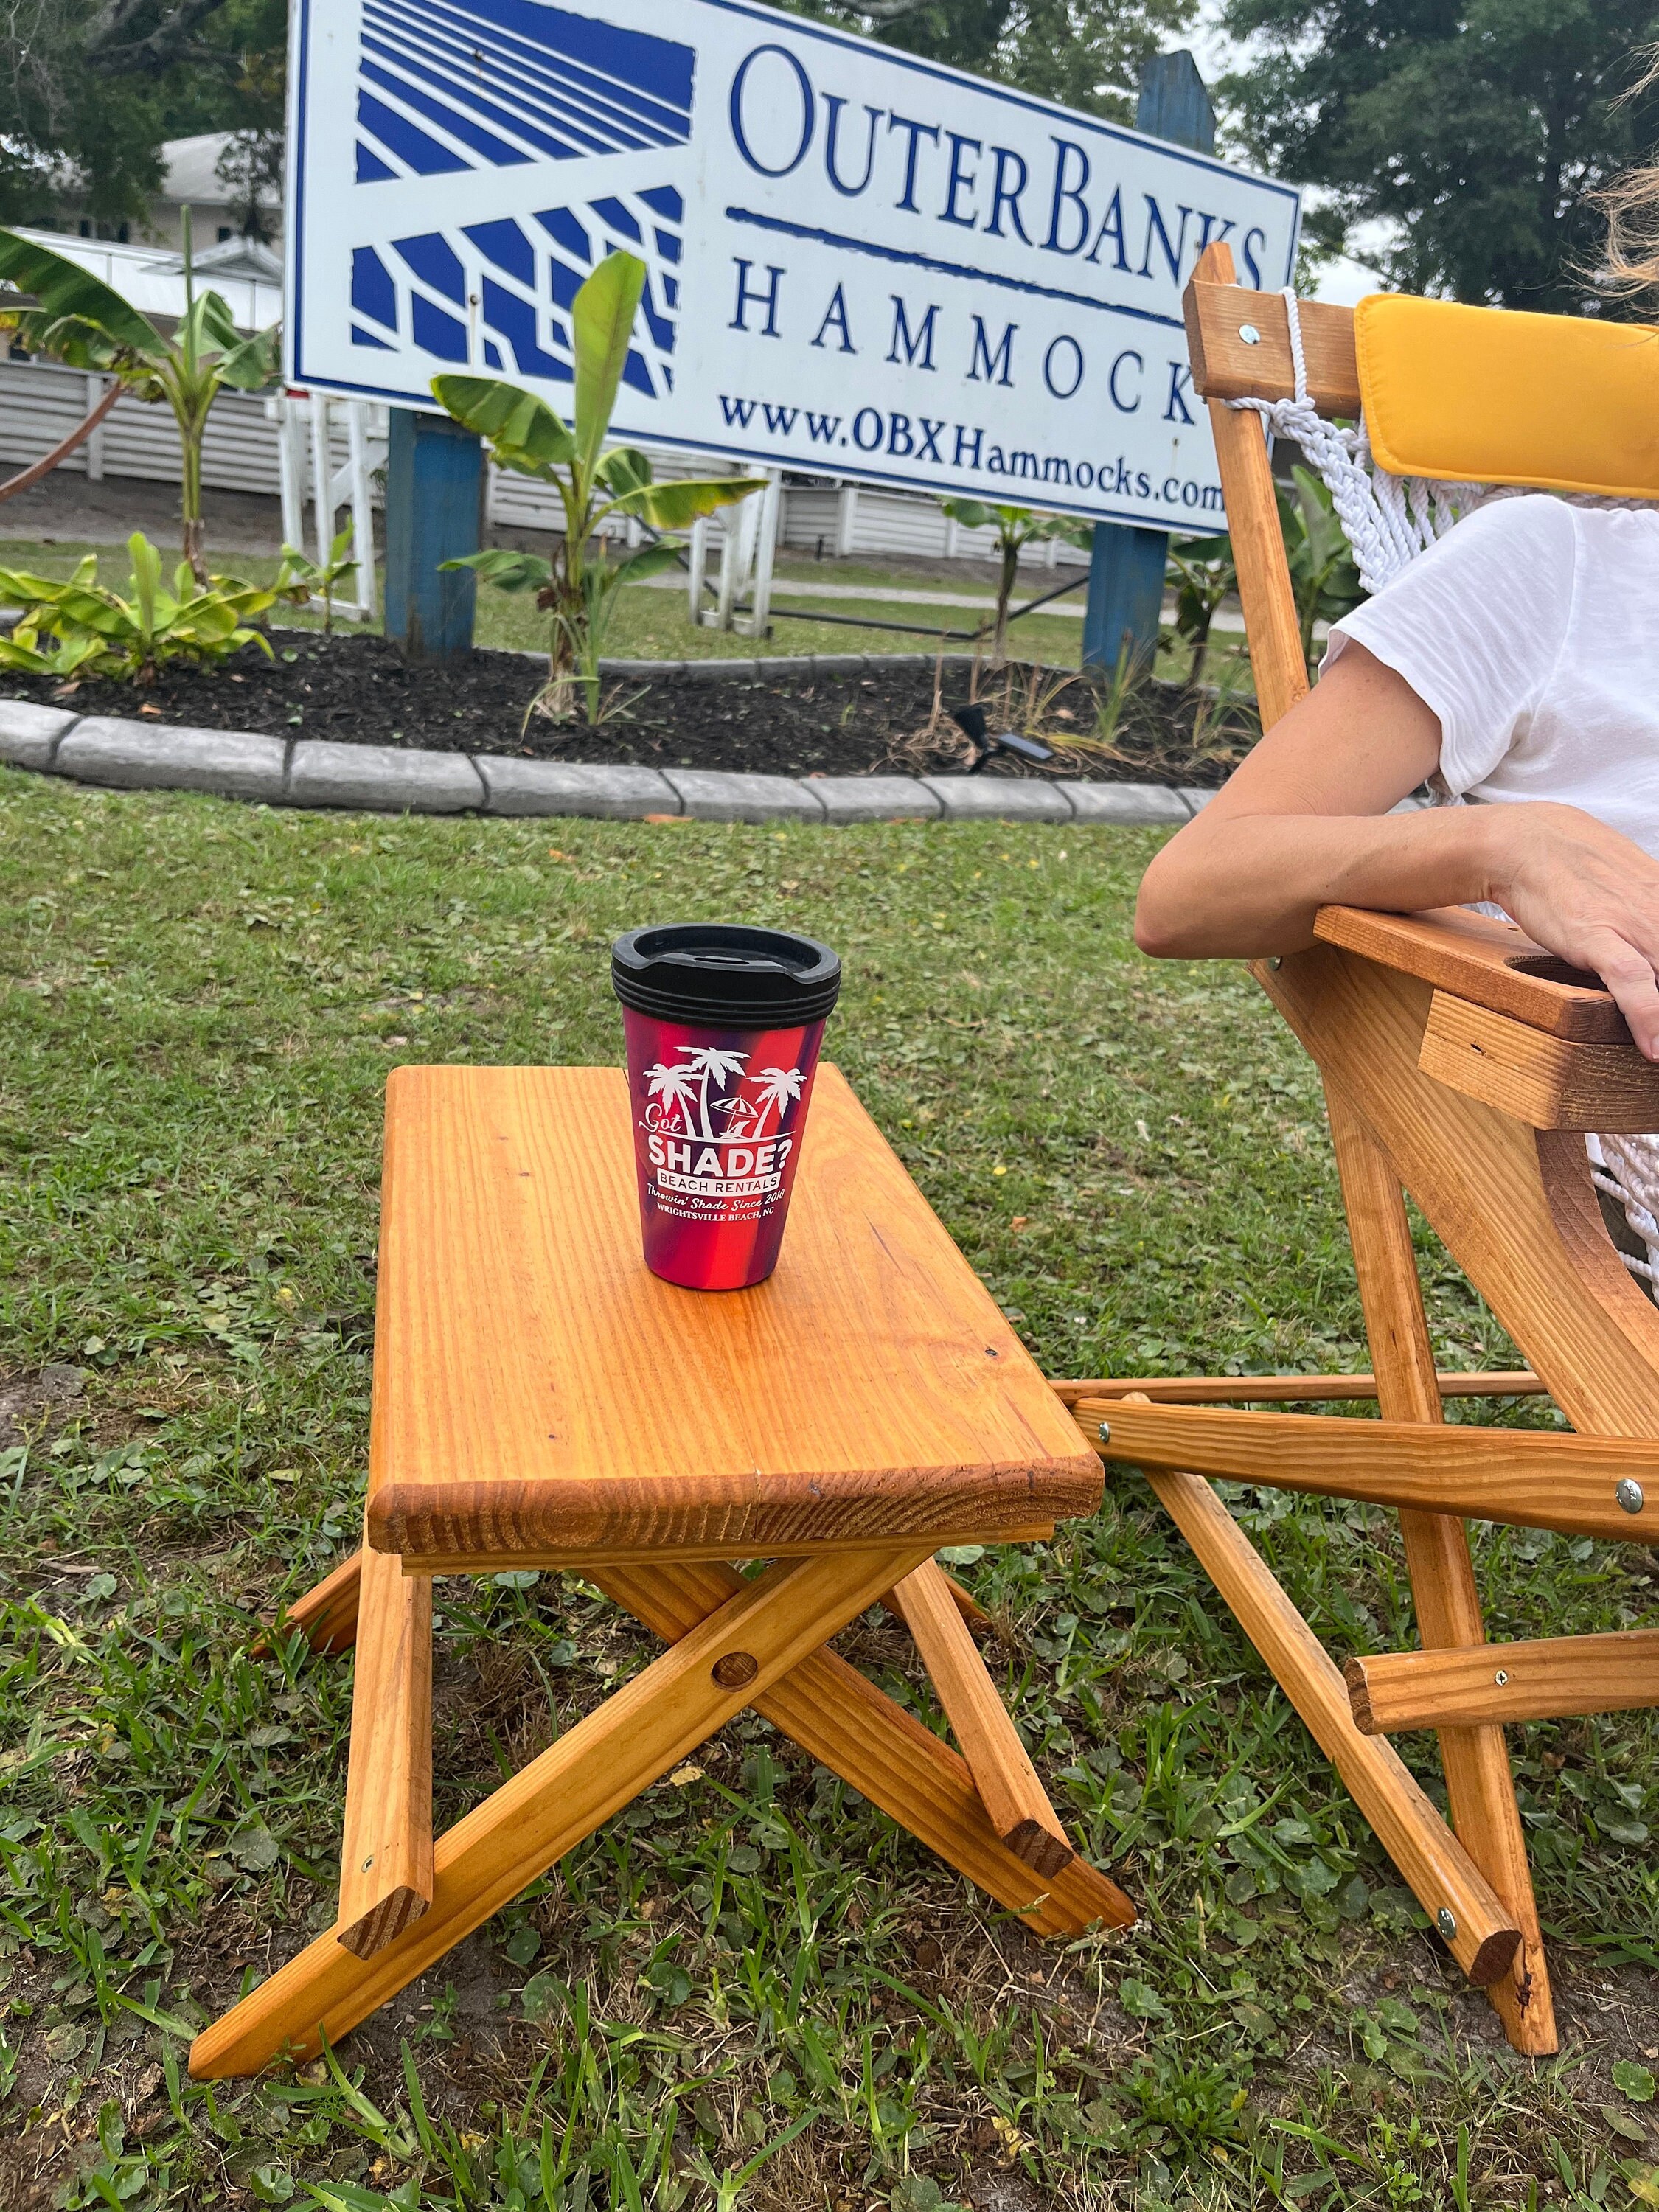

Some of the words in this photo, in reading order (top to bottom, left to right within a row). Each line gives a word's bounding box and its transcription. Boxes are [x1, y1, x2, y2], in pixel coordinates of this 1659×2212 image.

[719, 395, 1225, 511] www.OBXHammocks.com
[639, 1102, 683, 1133] Got
[648, 1134, 793, 1178] SHADE?
[647, 1183, 689, 1206] Throwin'
[690, 1198, 729, 1211] Shade
[731, 1199, 762, 1211] Since
[764, 1189, 785, 1205] 2010
[660, 1172, 708, 1192] BEACH
[715, 1177, 778, 1193] RENTALS
[656, 1203, 726, 1222] WRIGHTSVILLE
[728, 1211, 762, 1222] BEACH,
[762, 1207, 774, 1215] NC
